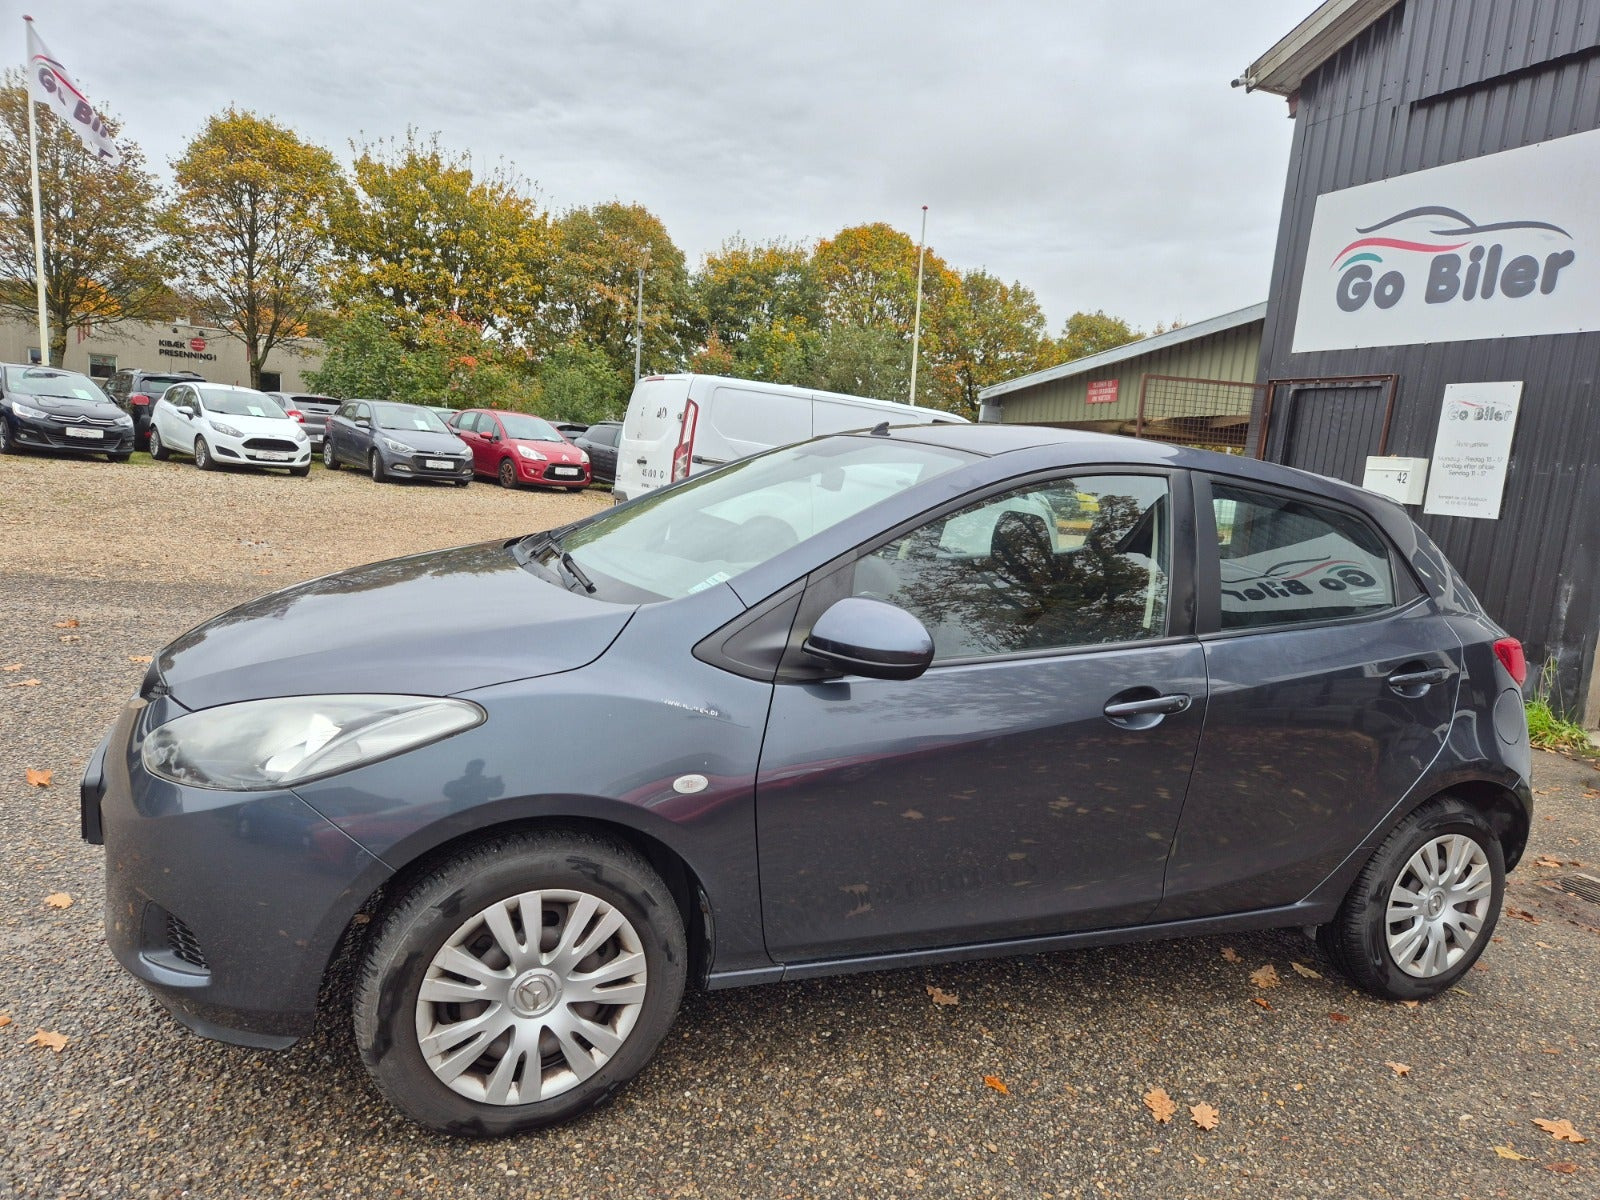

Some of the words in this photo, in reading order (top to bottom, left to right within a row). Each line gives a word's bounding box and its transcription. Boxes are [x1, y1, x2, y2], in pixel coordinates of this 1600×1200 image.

[1336, 264, 1405, 313] Go
[1425, 243, 1575, 304] Biler
[158, 339, 186, 349] KIBÆK
[1448, 407, 1469, 421] Go
[1473, 406, 1512, 421] Biler
[1396, 472, 1408, 484] 42
